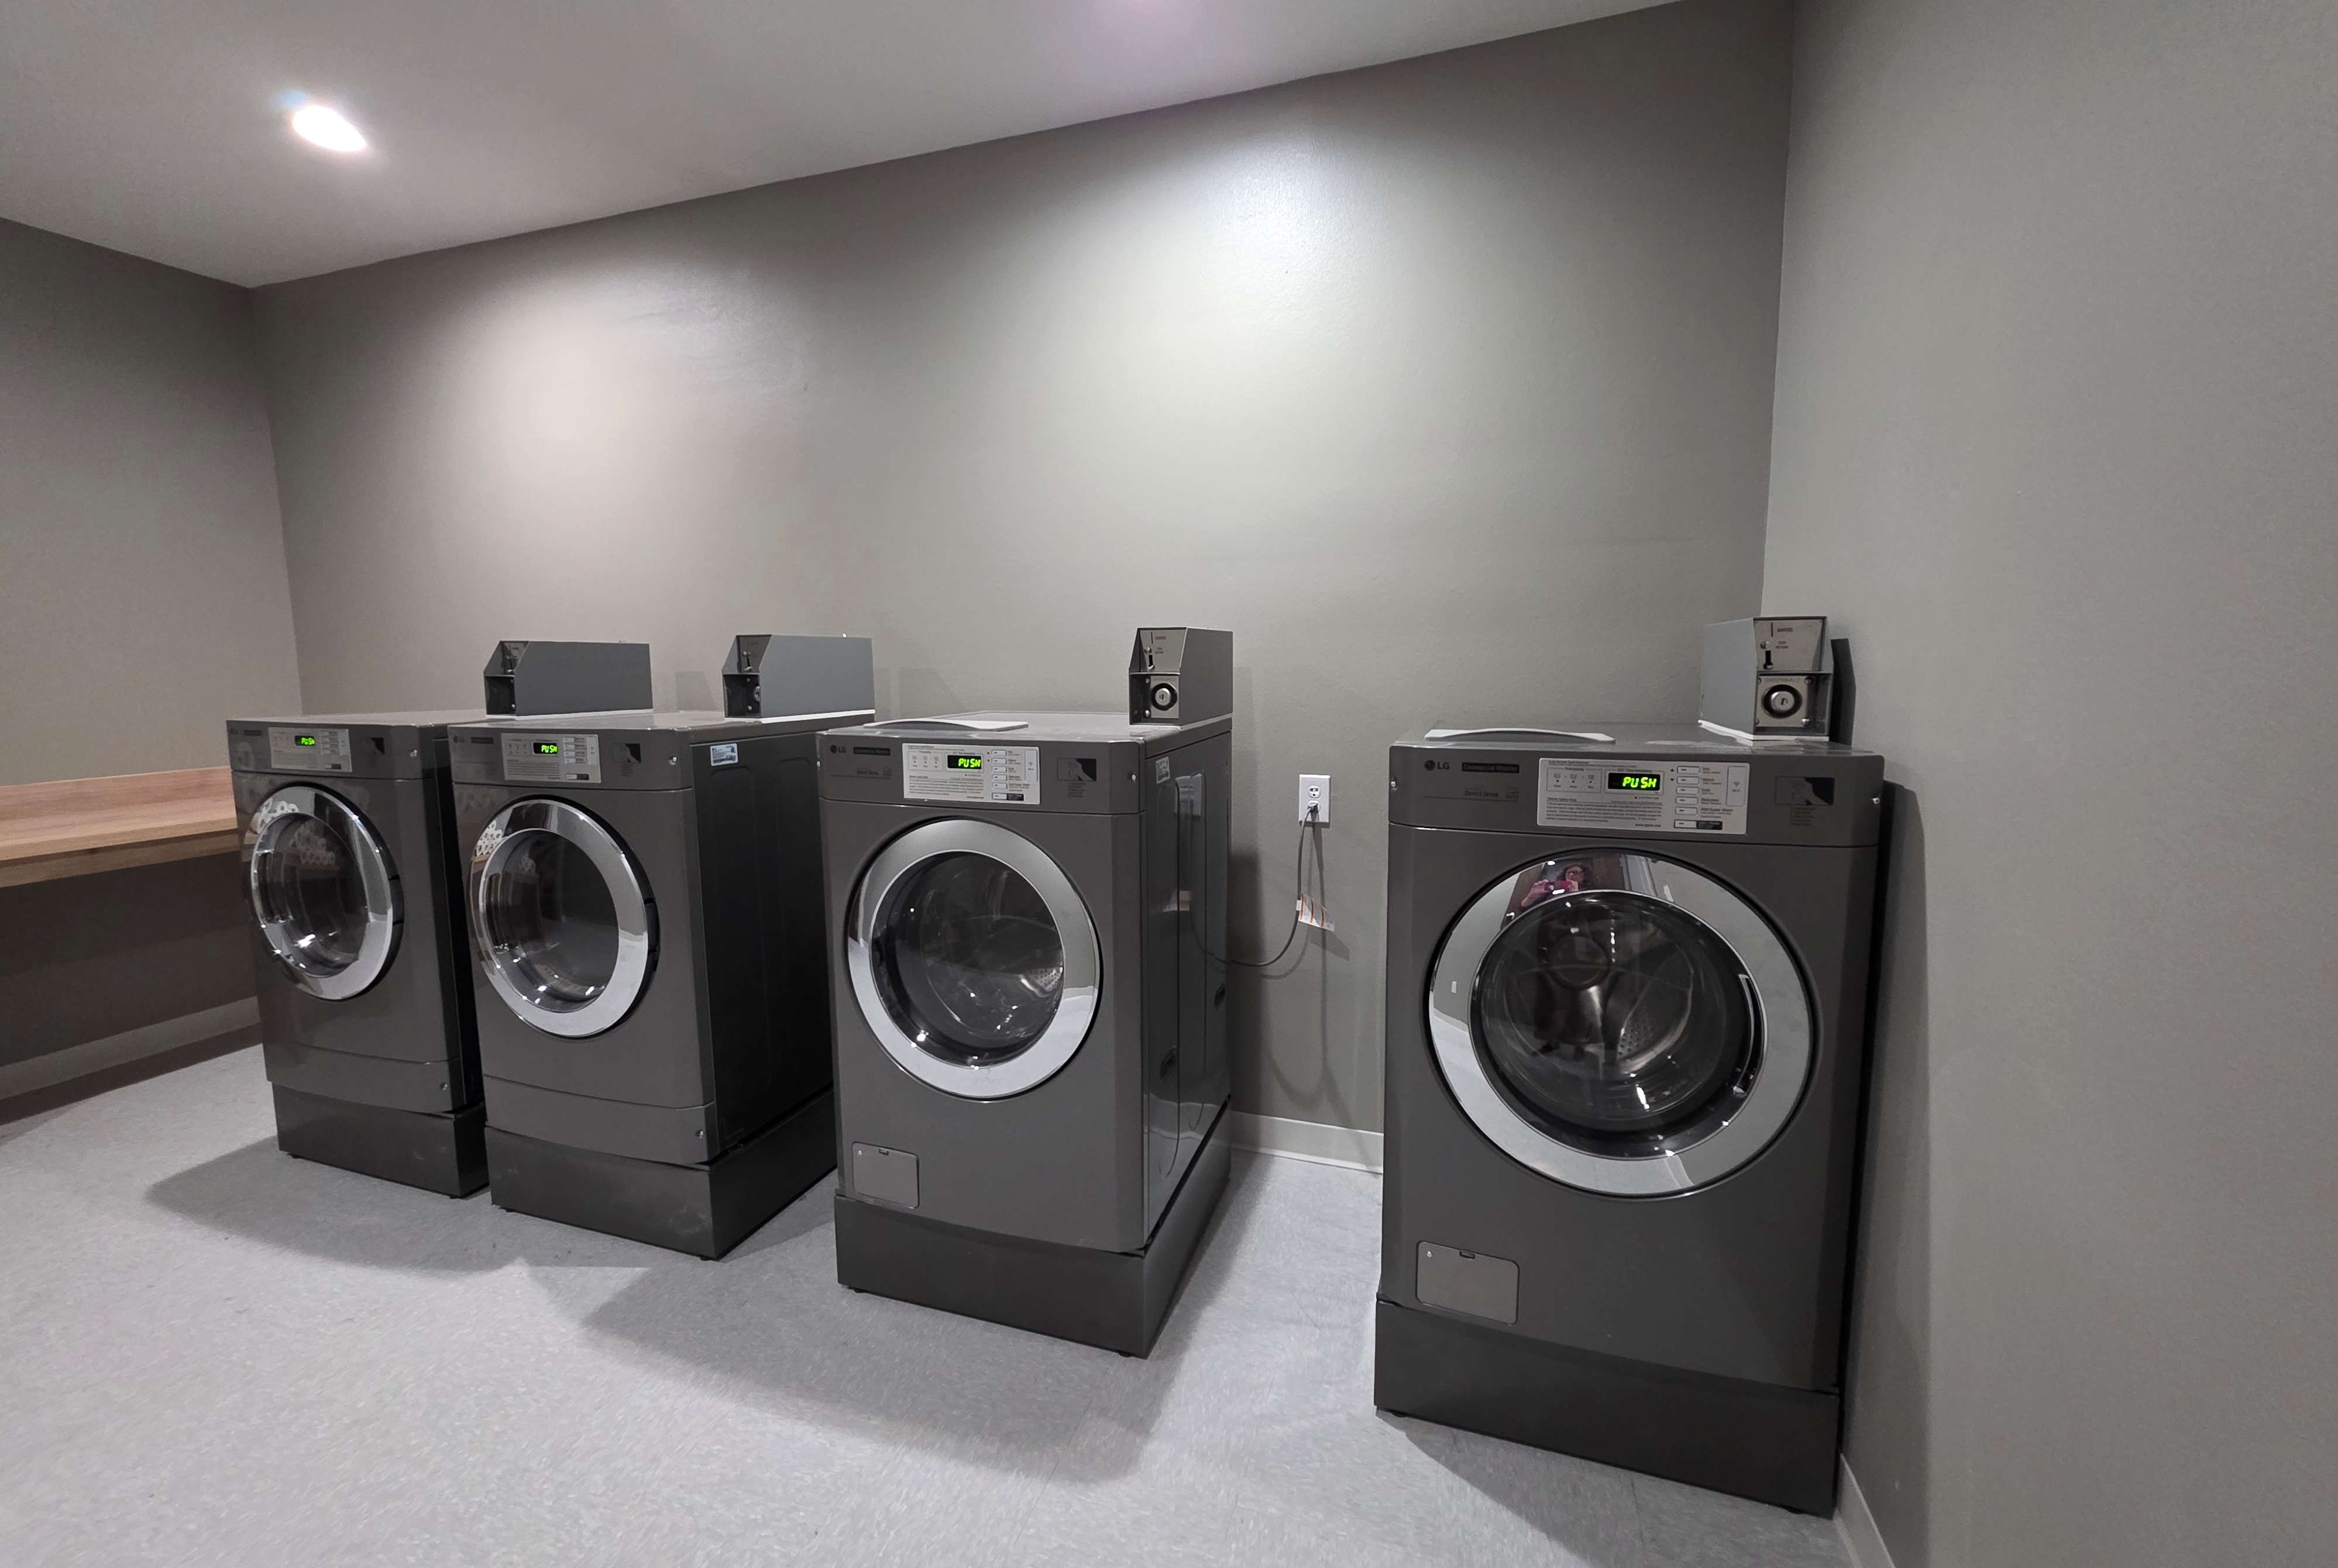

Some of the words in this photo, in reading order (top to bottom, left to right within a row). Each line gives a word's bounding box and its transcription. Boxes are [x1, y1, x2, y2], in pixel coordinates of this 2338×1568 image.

[958, 758, 981, 768] PUSH
[1437, 762, 1450, 770] LG
[1622, 776, 1658, 789] PUSH
